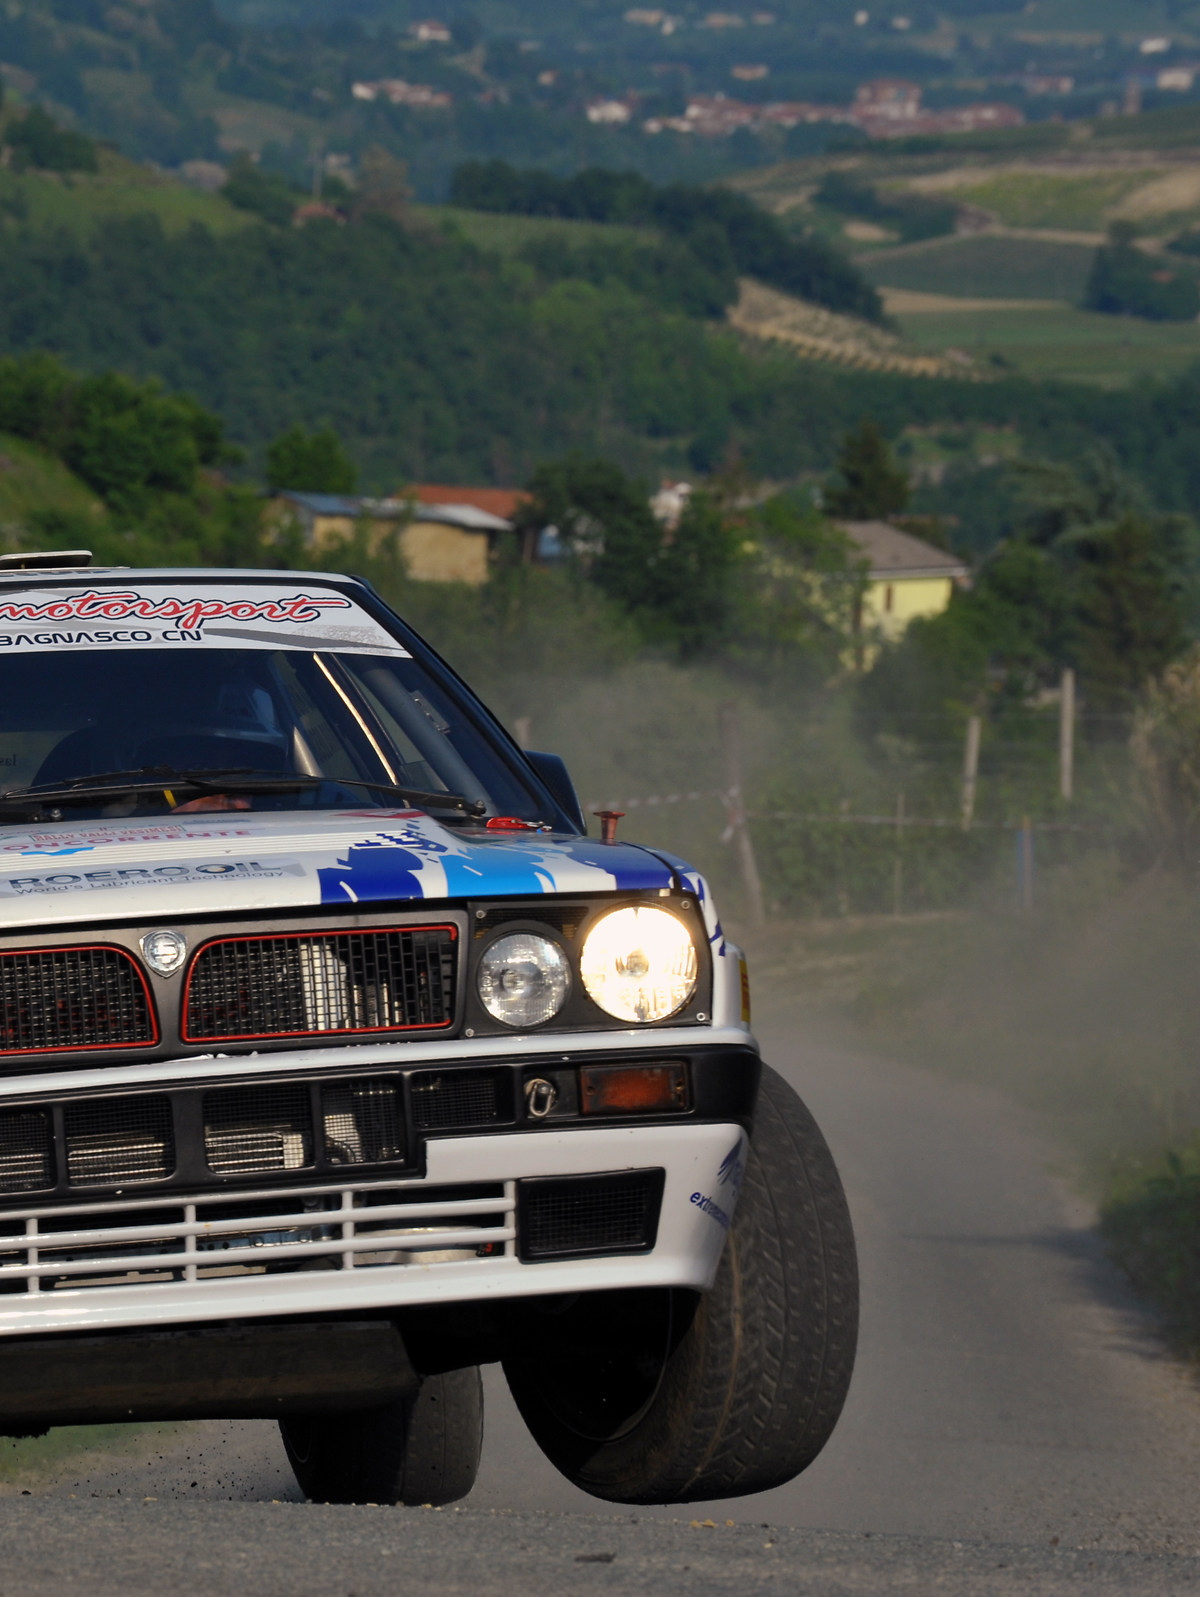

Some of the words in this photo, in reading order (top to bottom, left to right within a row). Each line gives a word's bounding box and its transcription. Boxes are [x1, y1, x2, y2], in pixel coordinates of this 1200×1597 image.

[162, 630, 203, 642] CN
[15, 885, 84, 895] World's
[90, 877, 175, 887] Lubricant
[183, 871, 284, 881] Technology
